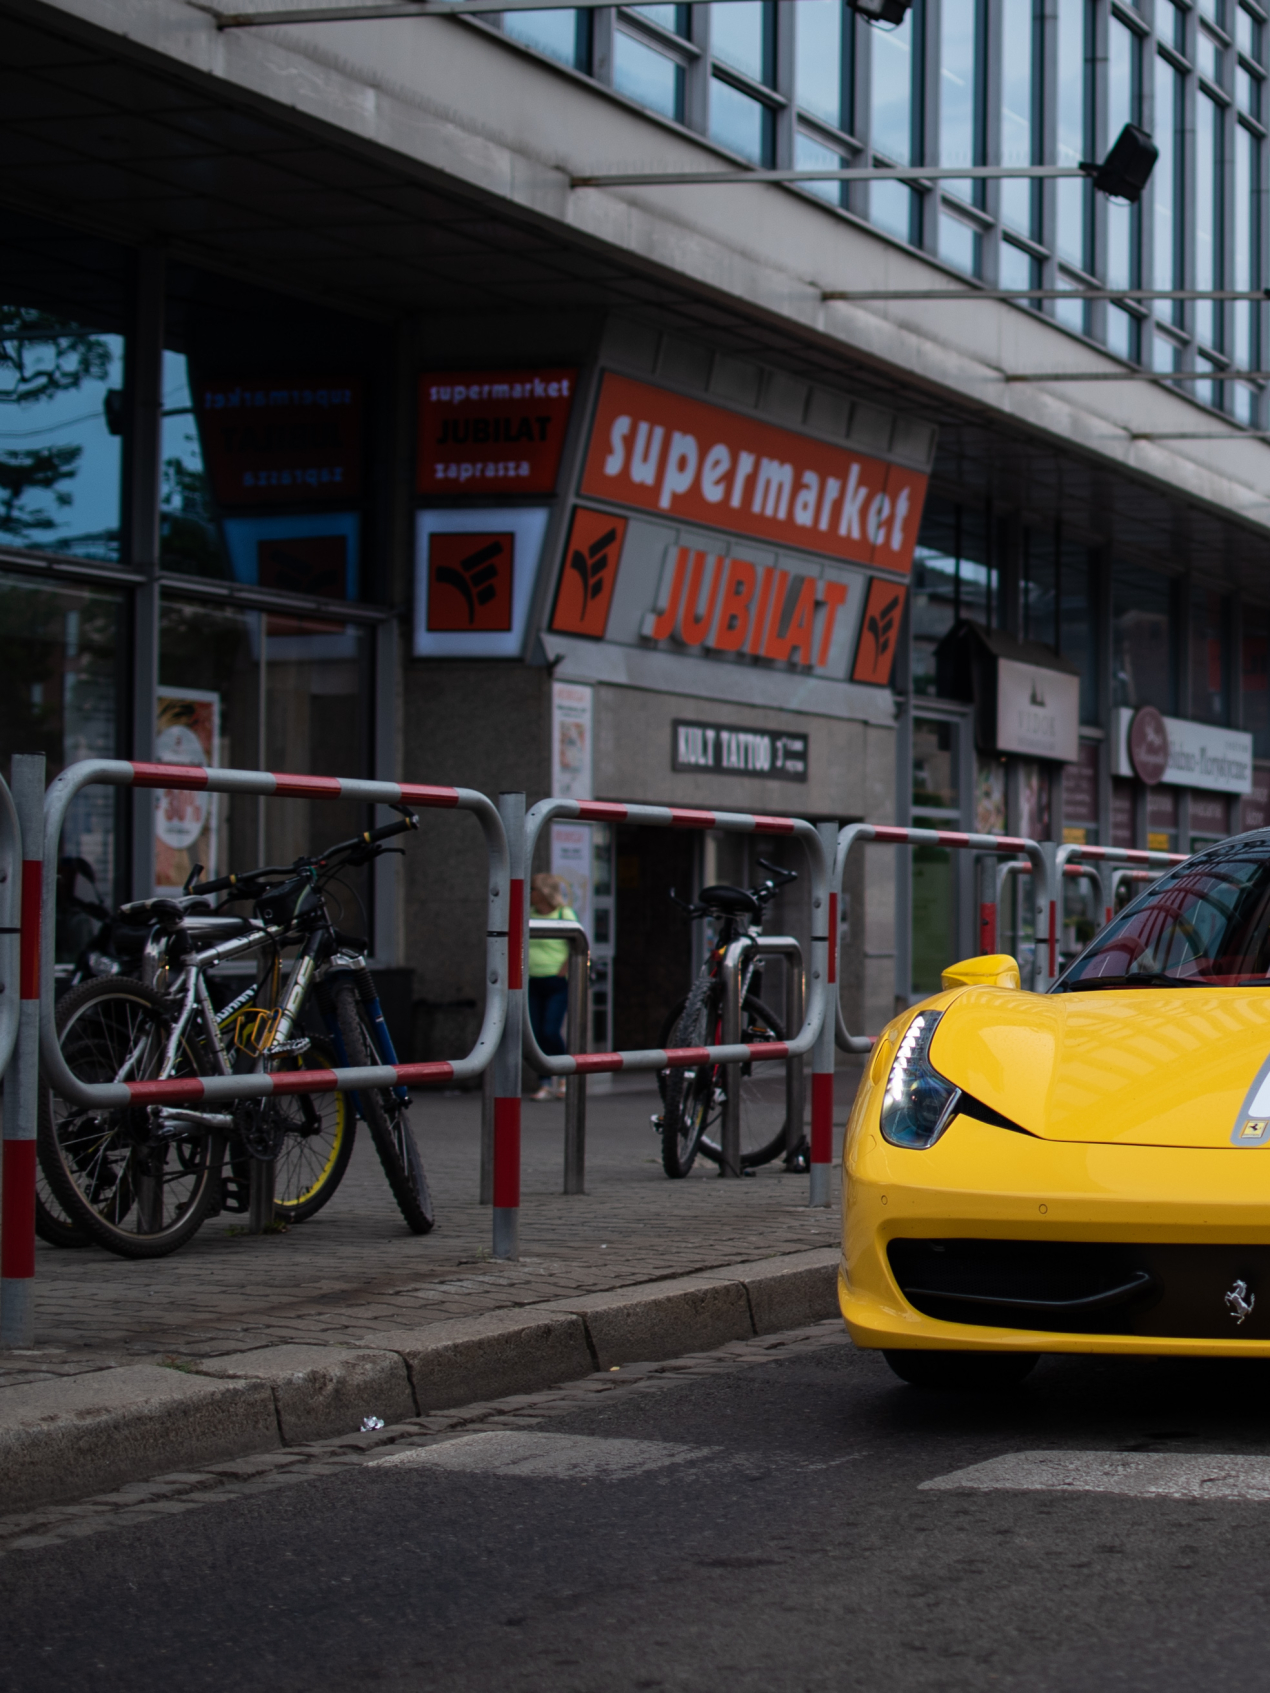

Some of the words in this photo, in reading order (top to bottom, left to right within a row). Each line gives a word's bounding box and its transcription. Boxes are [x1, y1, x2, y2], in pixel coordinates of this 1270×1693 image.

[429, 377, 570, 405] supermarket
[436, 415, 551, 444] JUBILAT
[434, 460, 530, 484] zaprasza
[603, 413, 912, 553] supermarket
[646, 545, 849, 668] JUBILAT
[677, 725, 716, 767] KULT
[720, 730, 772, 772] TATTOO
